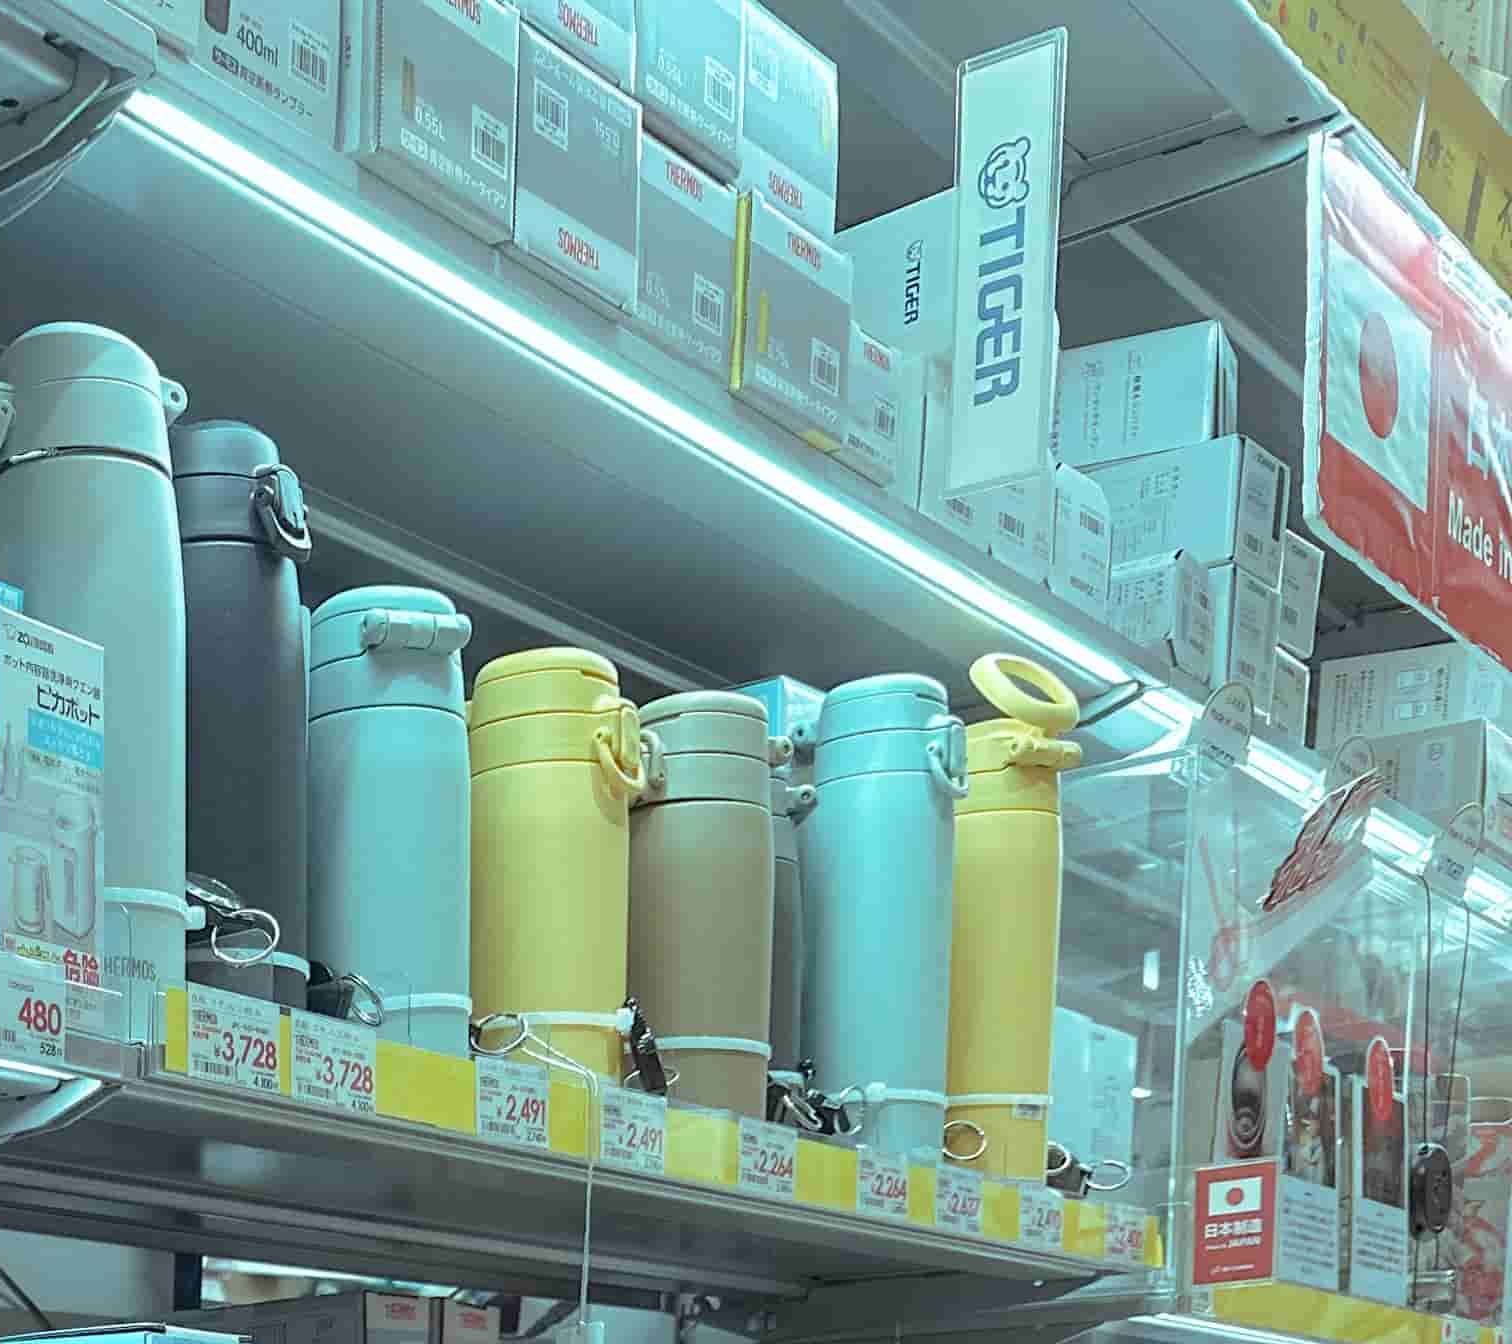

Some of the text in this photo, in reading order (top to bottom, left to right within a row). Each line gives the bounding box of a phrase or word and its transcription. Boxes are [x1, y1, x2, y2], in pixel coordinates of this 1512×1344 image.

[237, 23, 280, 67] 400ml
[665, 160, 703, 201] THERMOS
[557, 227, 600, 271] THERMOS
[903, 262, 921, 325] TIGER
[973, 205, 1026, 408] TIGER
[1447, 488, 1494, 568] Made
[103, 952, 156, 982] HERMOS
[18, 997, 63, 1036] 480
[221, 1031, 278, 1071] 3,728
[322, 1056, 375, 1095] 3,728
[505, 1094, 547, 1128] 2,491
